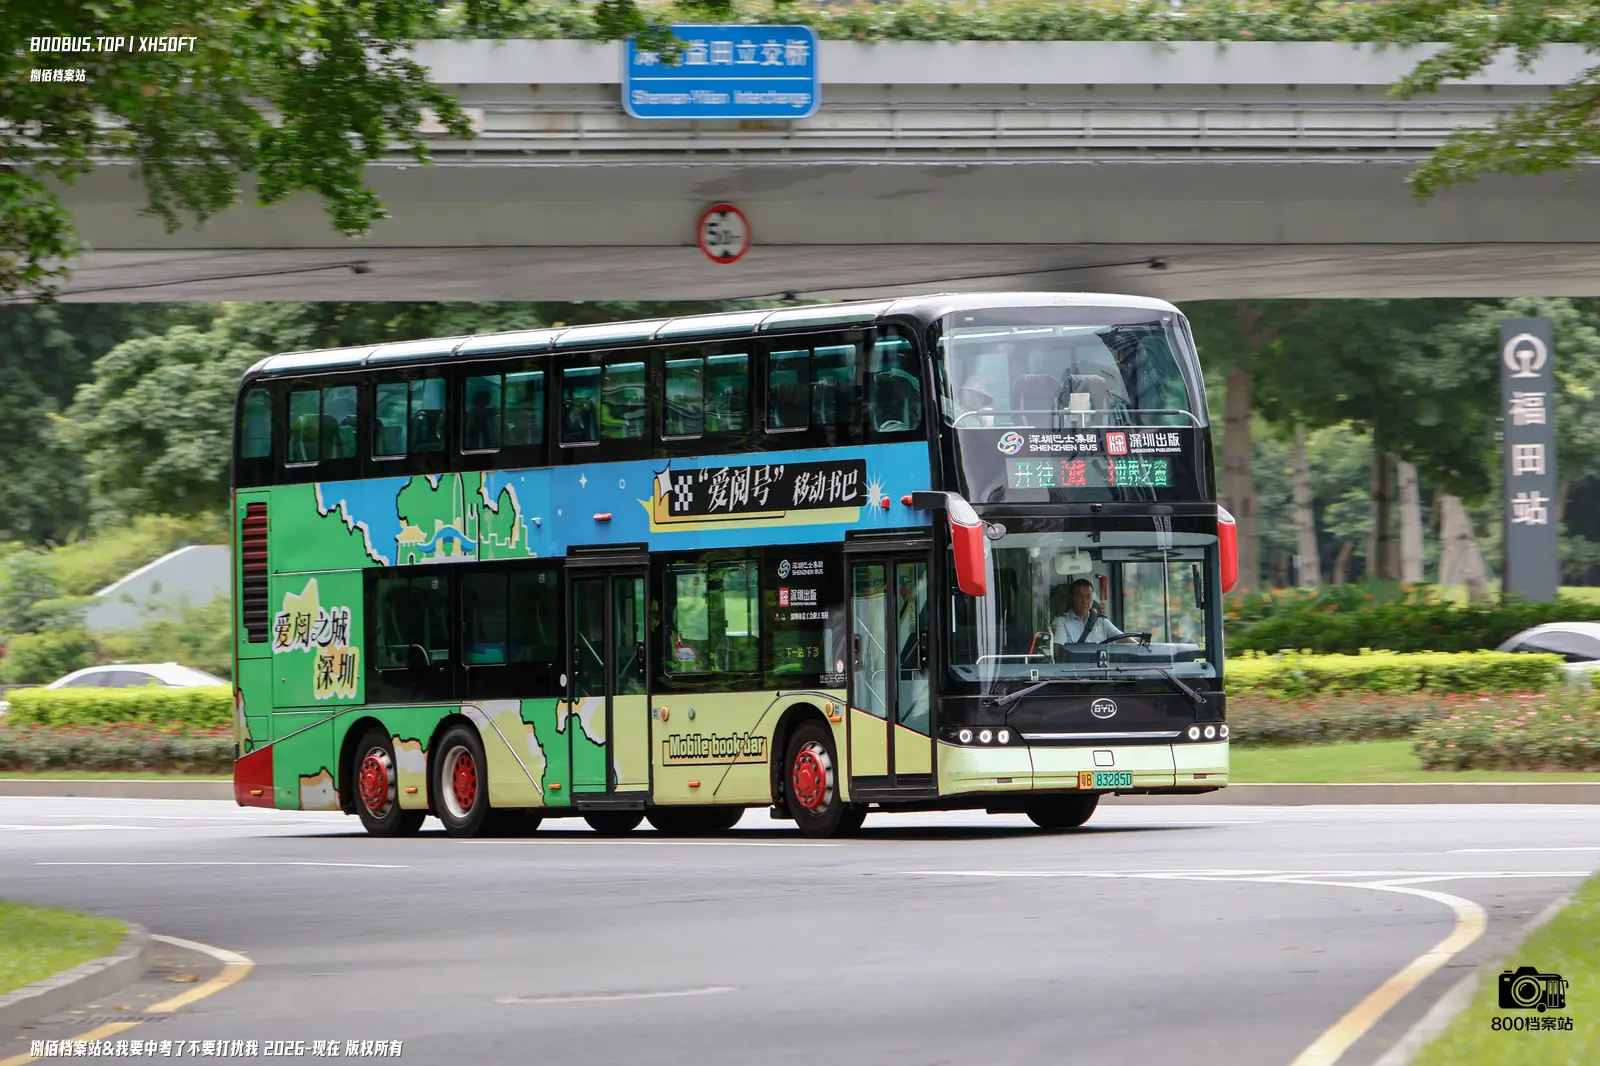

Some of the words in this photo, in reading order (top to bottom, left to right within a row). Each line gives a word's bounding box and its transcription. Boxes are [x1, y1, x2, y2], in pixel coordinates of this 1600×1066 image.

[1028, 433, 1098, 444] 深圳巴士集团
[1129, 432, 1181, 447] 深圳出版
[1029, 444, 1078, 452] SHENZHEN
[1079, 444, 1098, 452] BUS
[1508, 391, 1550, 525] 福田站
[275, 610, 348, 649] 爱阅之城
[316, 653, 356, 690] 深圳
[1094, 704, 1115, 713] BYD
[669, 733, 709, 759] Mobile
[711, 732, 741, 757] book
[743, 732, 764, 756] bar
[1096, 773, 1132, 787] 83285D
